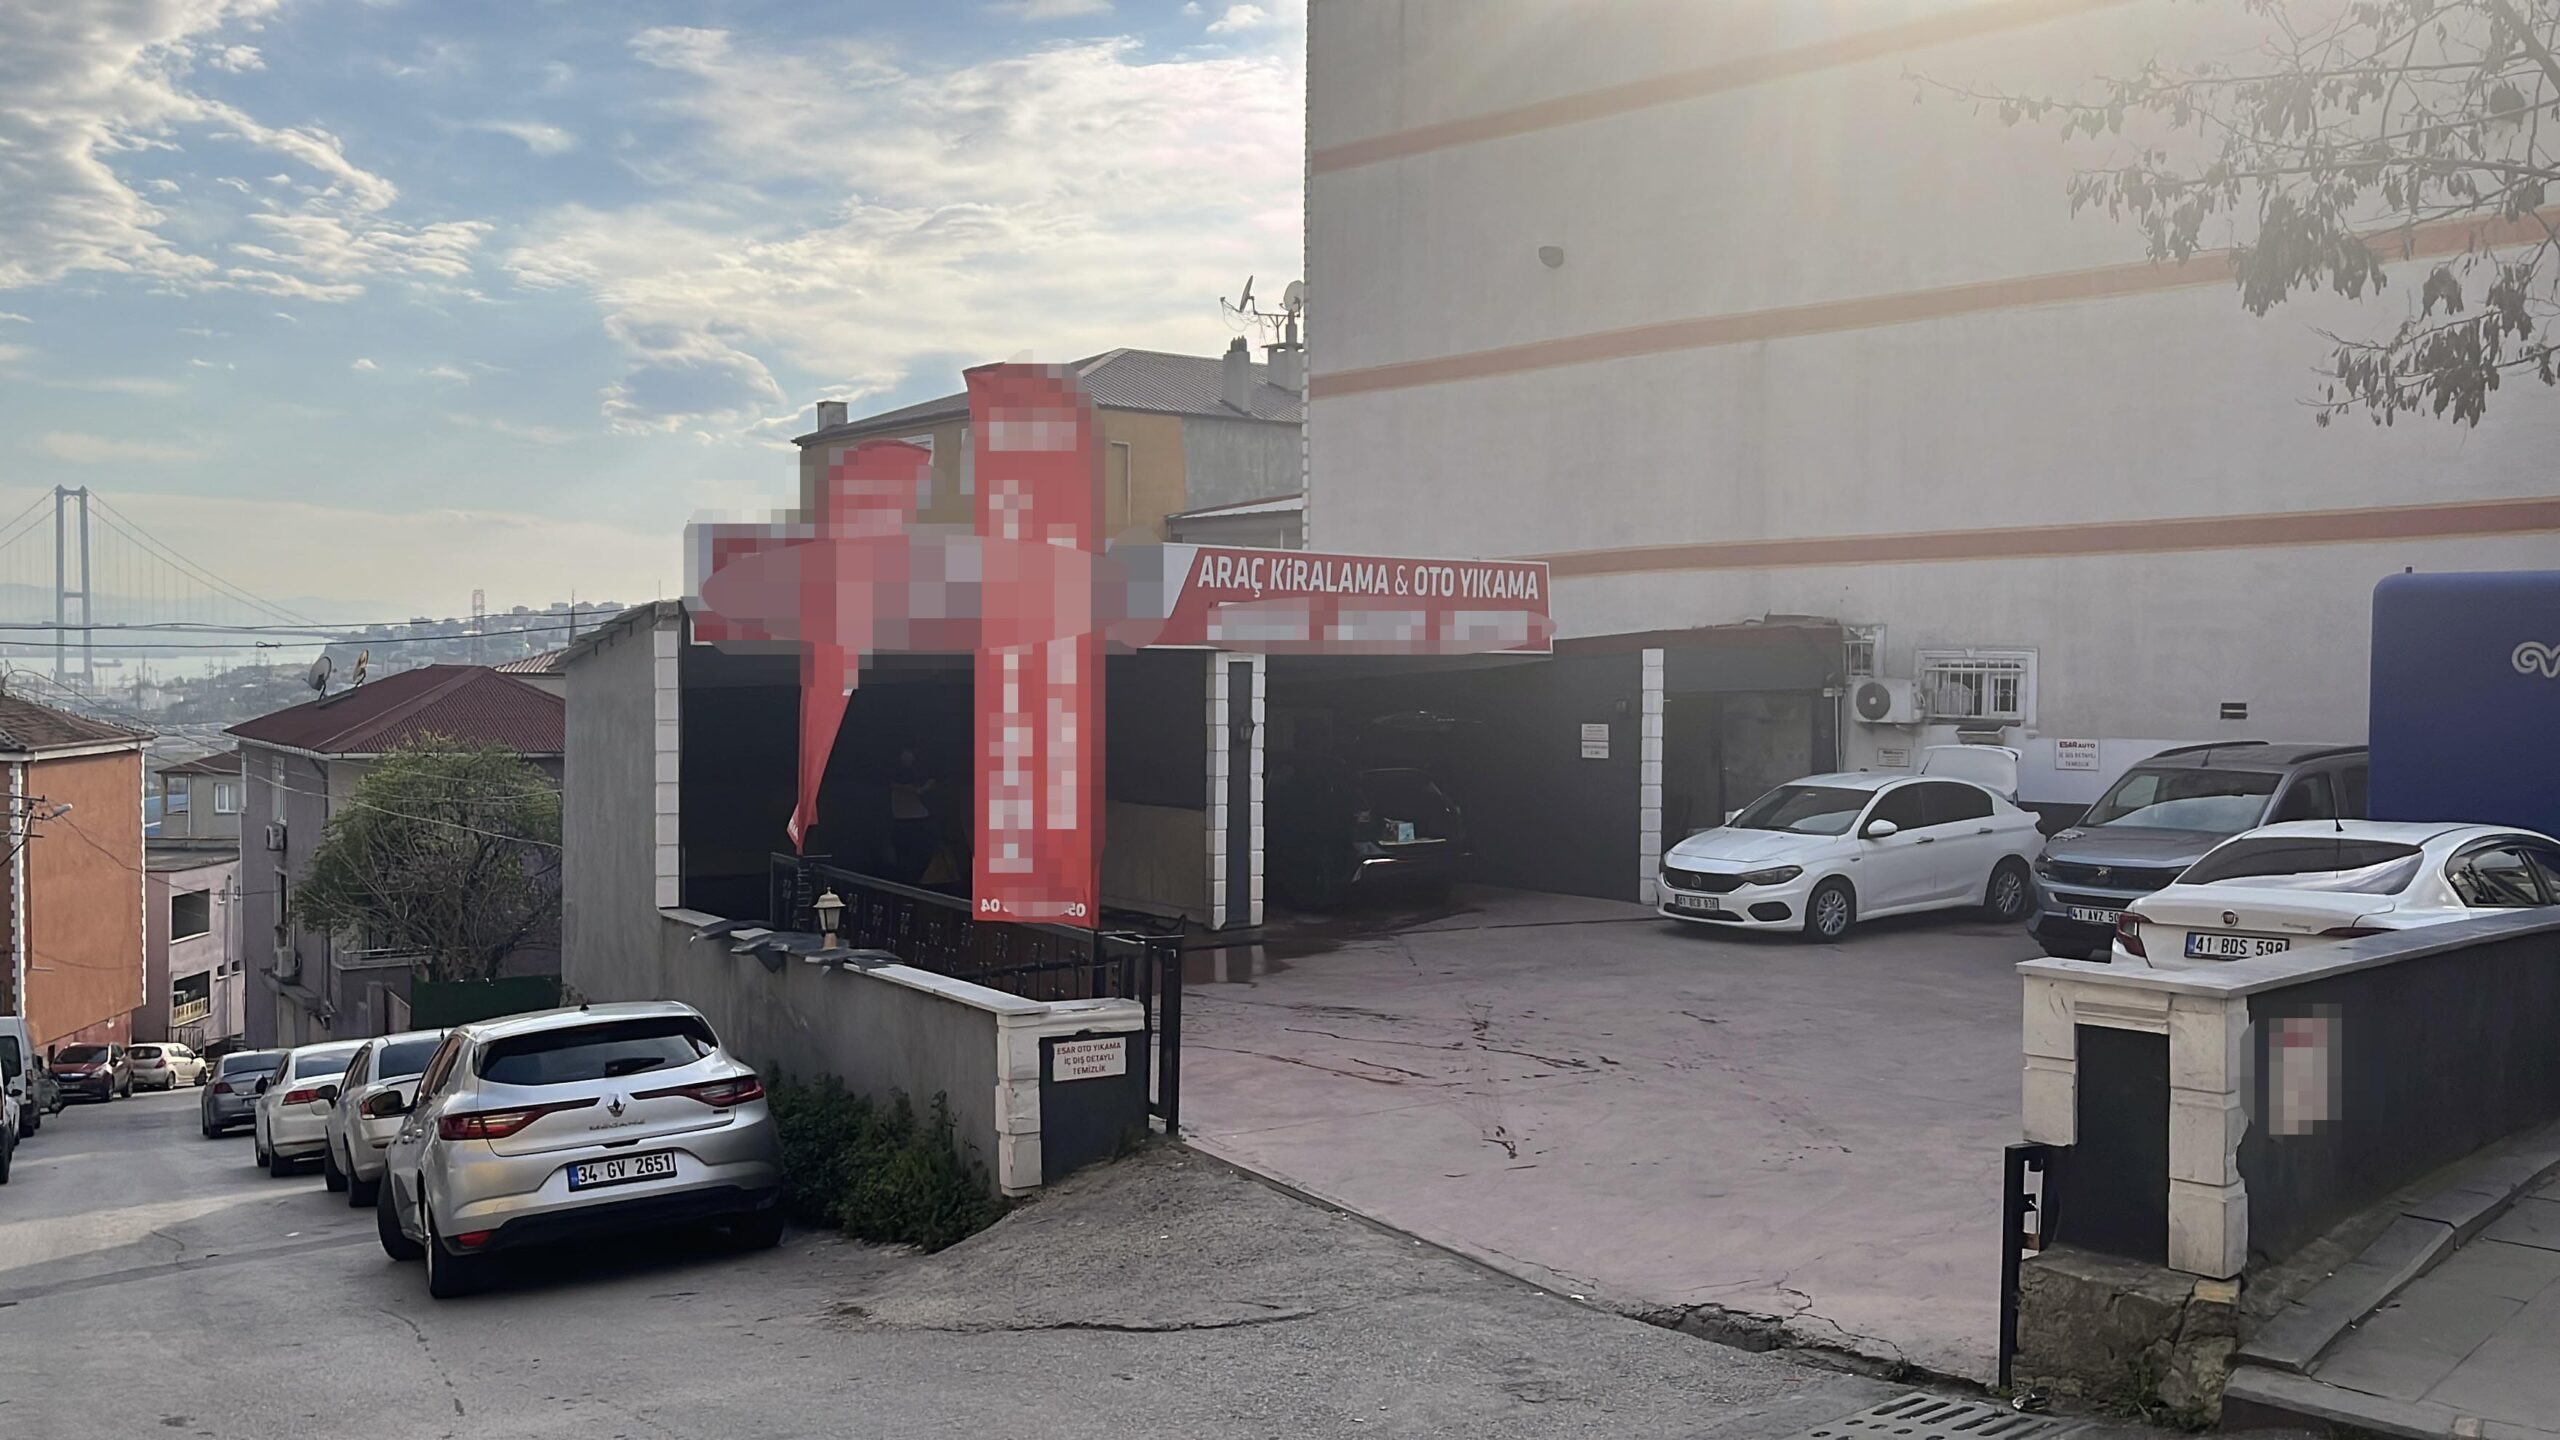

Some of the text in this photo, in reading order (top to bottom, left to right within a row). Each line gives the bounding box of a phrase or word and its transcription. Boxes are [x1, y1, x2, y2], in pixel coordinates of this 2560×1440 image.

[1197, 555, 1265, 598] ARAÇ
[1394, 564, 1409, 596] &
[1414, 565, 1455, 597] OTO
[1460, 567, 1539, 600] YIKAMA
[2088, 910, 2104, 922] AVZ
[2196, 937, 2212, 953] 41
[2221, 938, 2247, 955] BDS
[1057, 1042, 1121, 1055] ESAR OTO YIKAMA
[1086, 1054, 1114, 1063] DETAYLI
[578, 1154, 671, 1183] 34 GV 2651
